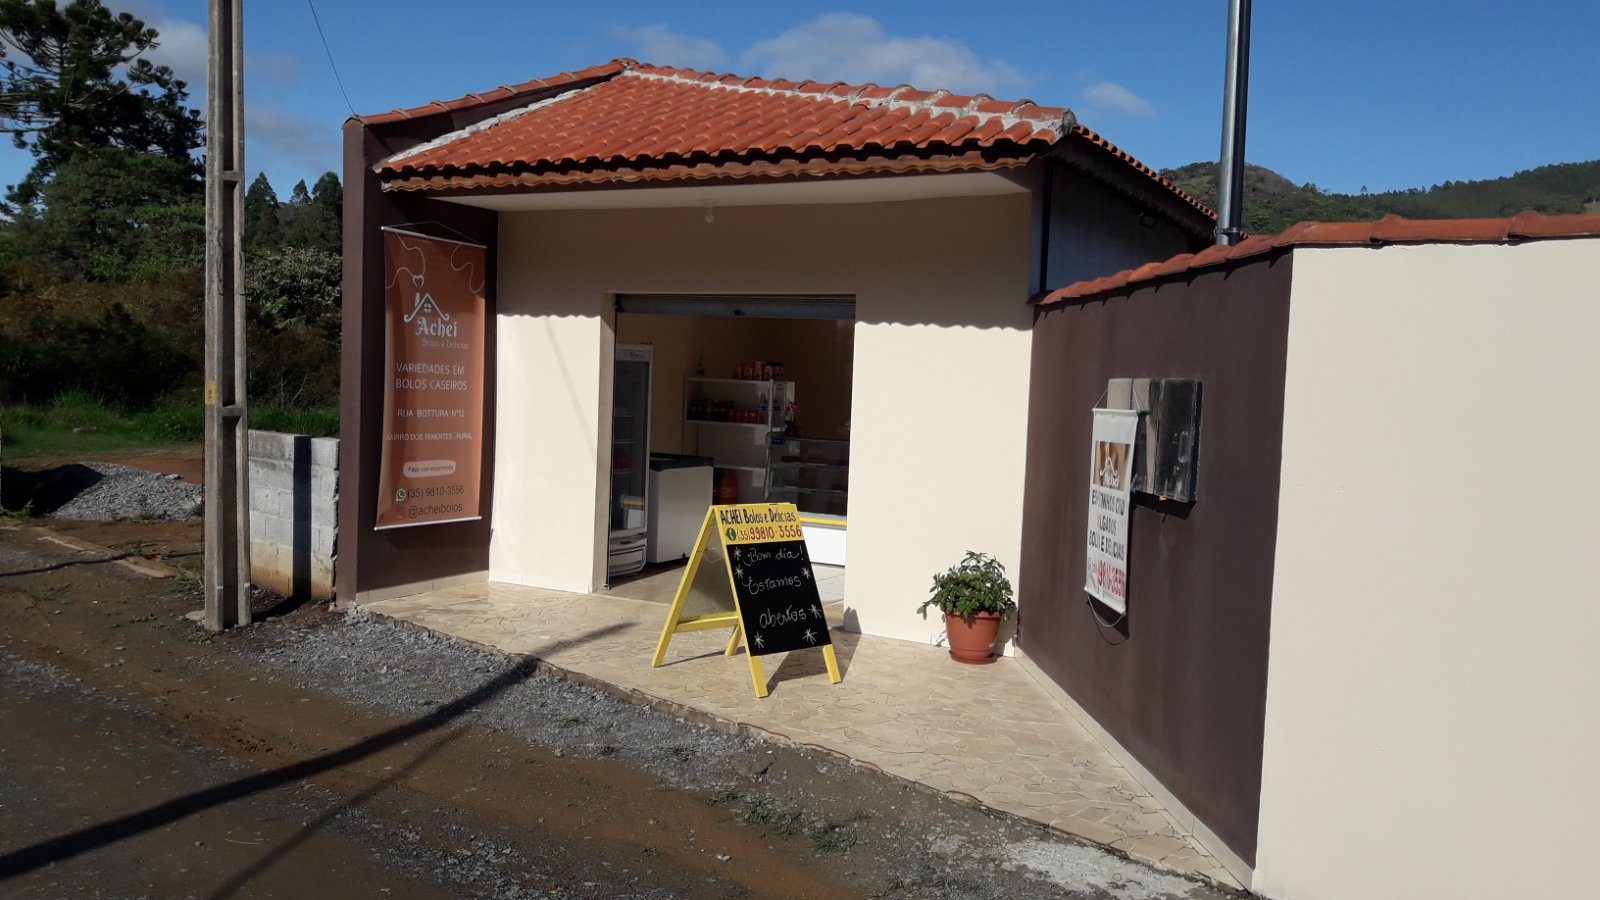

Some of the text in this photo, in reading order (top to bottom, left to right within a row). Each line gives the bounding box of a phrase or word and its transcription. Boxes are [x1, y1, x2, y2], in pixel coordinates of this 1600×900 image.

[415, 316, 457, 337] Achei
[396, 362, 465, 376] VARIEDADES EM
[395, 378, 468, 391] BOLOS CASEIROS
[397, 409, 414, 417] RUA
[416, 409, 449, 418] BOTTURA
[385, 433, 410, 441] BAIRRO
[410, 433, 424, 441] DOS
[407, 487, 424, 499] (35)
[408, 502, 464, 519] @acheibolos
[720, 509, 743, 525] ACHEI
[743, 508, 764, 524] Bolos
[764, 512, 769, 523] e
[1101, 535, 1105, 552] E
[743, 547, 772, 567] Bom
[742, 575, 802, 595] Estamos
[760, 604, 807, 629] abertos
